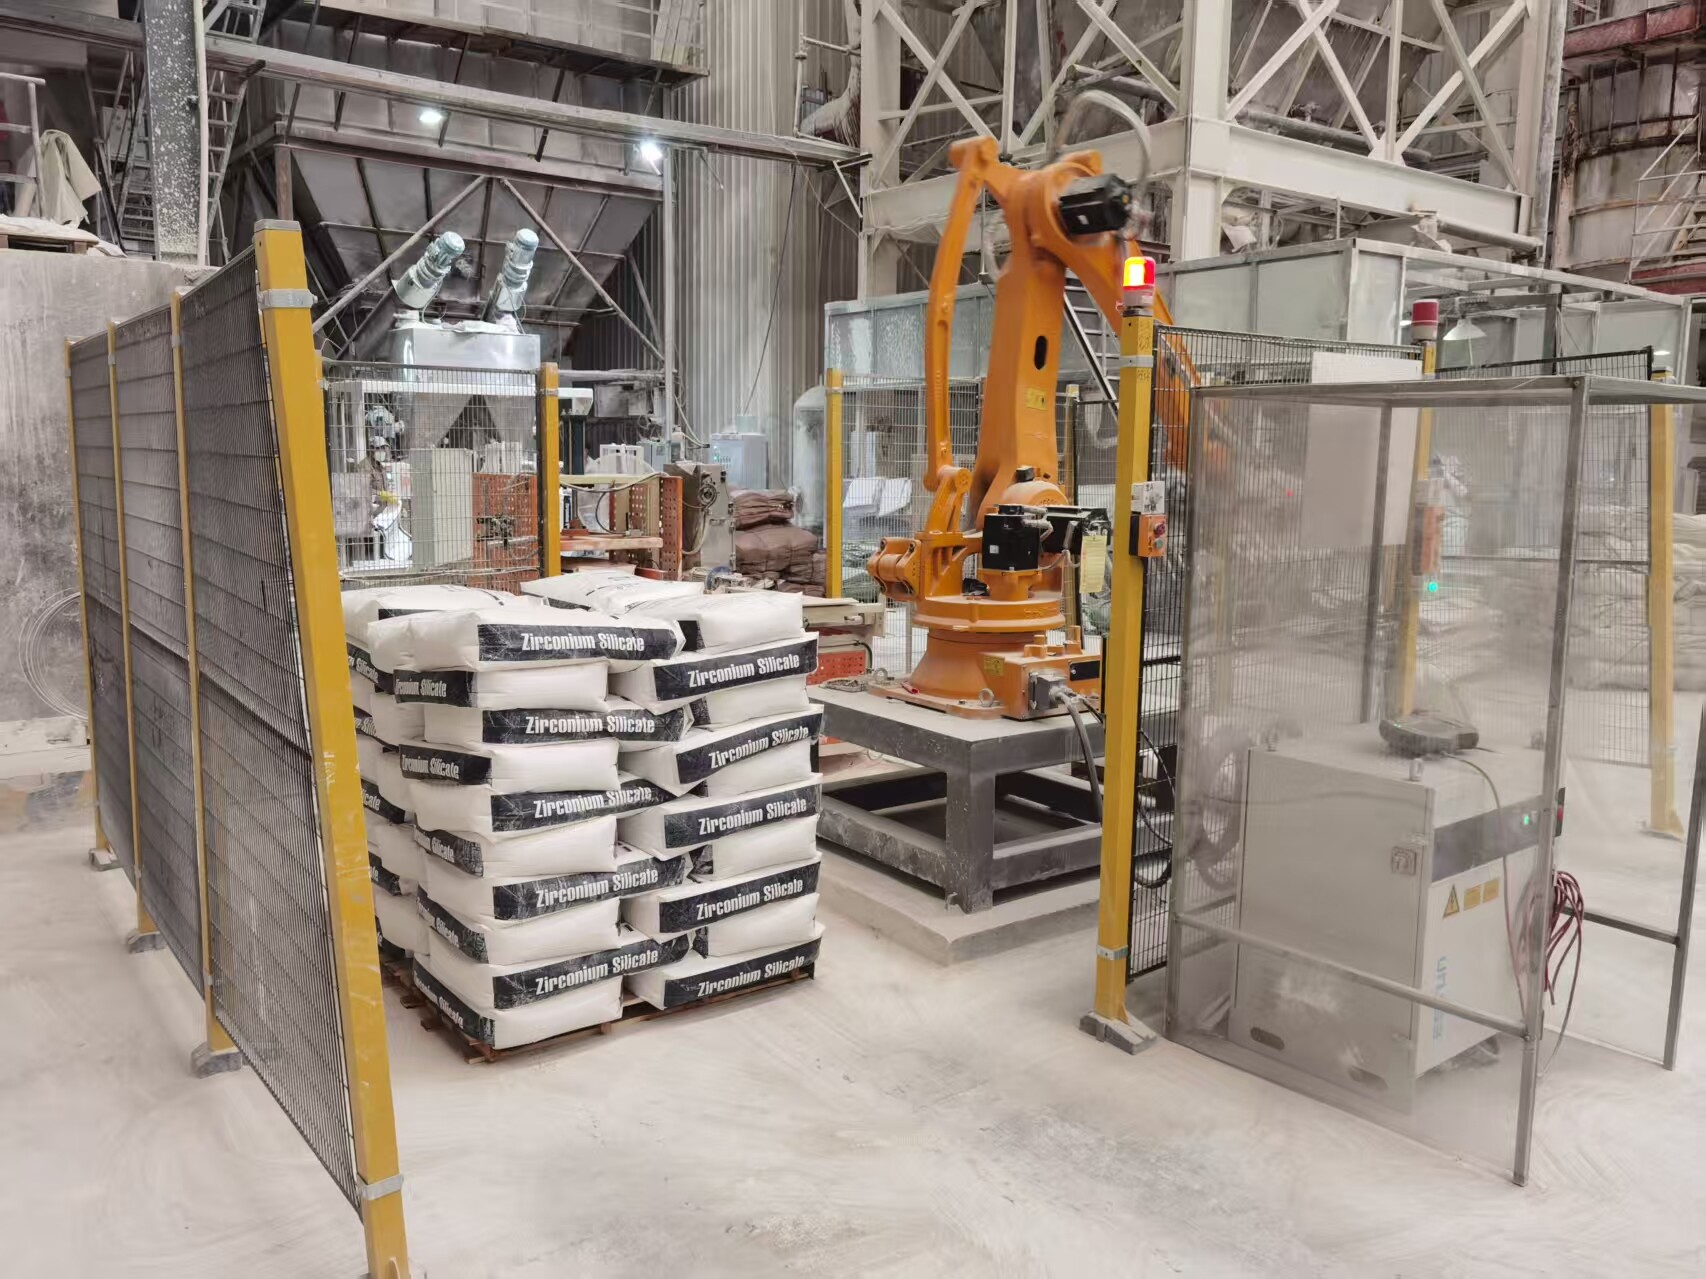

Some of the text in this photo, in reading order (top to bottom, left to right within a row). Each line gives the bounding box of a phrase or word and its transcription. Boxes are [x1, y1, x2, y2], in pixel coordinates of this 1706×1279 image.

[521, 633, 645, 651] Zirconium Silicate
[688, 653, 800, 688] Zirconium Silicate
[525, 715, 655, 734] Zirconium Silicate
[709, 726, 809, 769] Zirconium Silicate
[430, 757, 460, 780] Silicate
[533, 786, 652, 819] Zirconium Silicate
[698, 798, 807, 835] Zirconium Silicate
[536, 869, 659, 908] Zirconium Silicate
[696, 878, 803, 920] Zirconium Silicate
[536, 949, 659, 995] Zirconium Silicate
[697, 955, 805, 997] Zirconium Silicate
